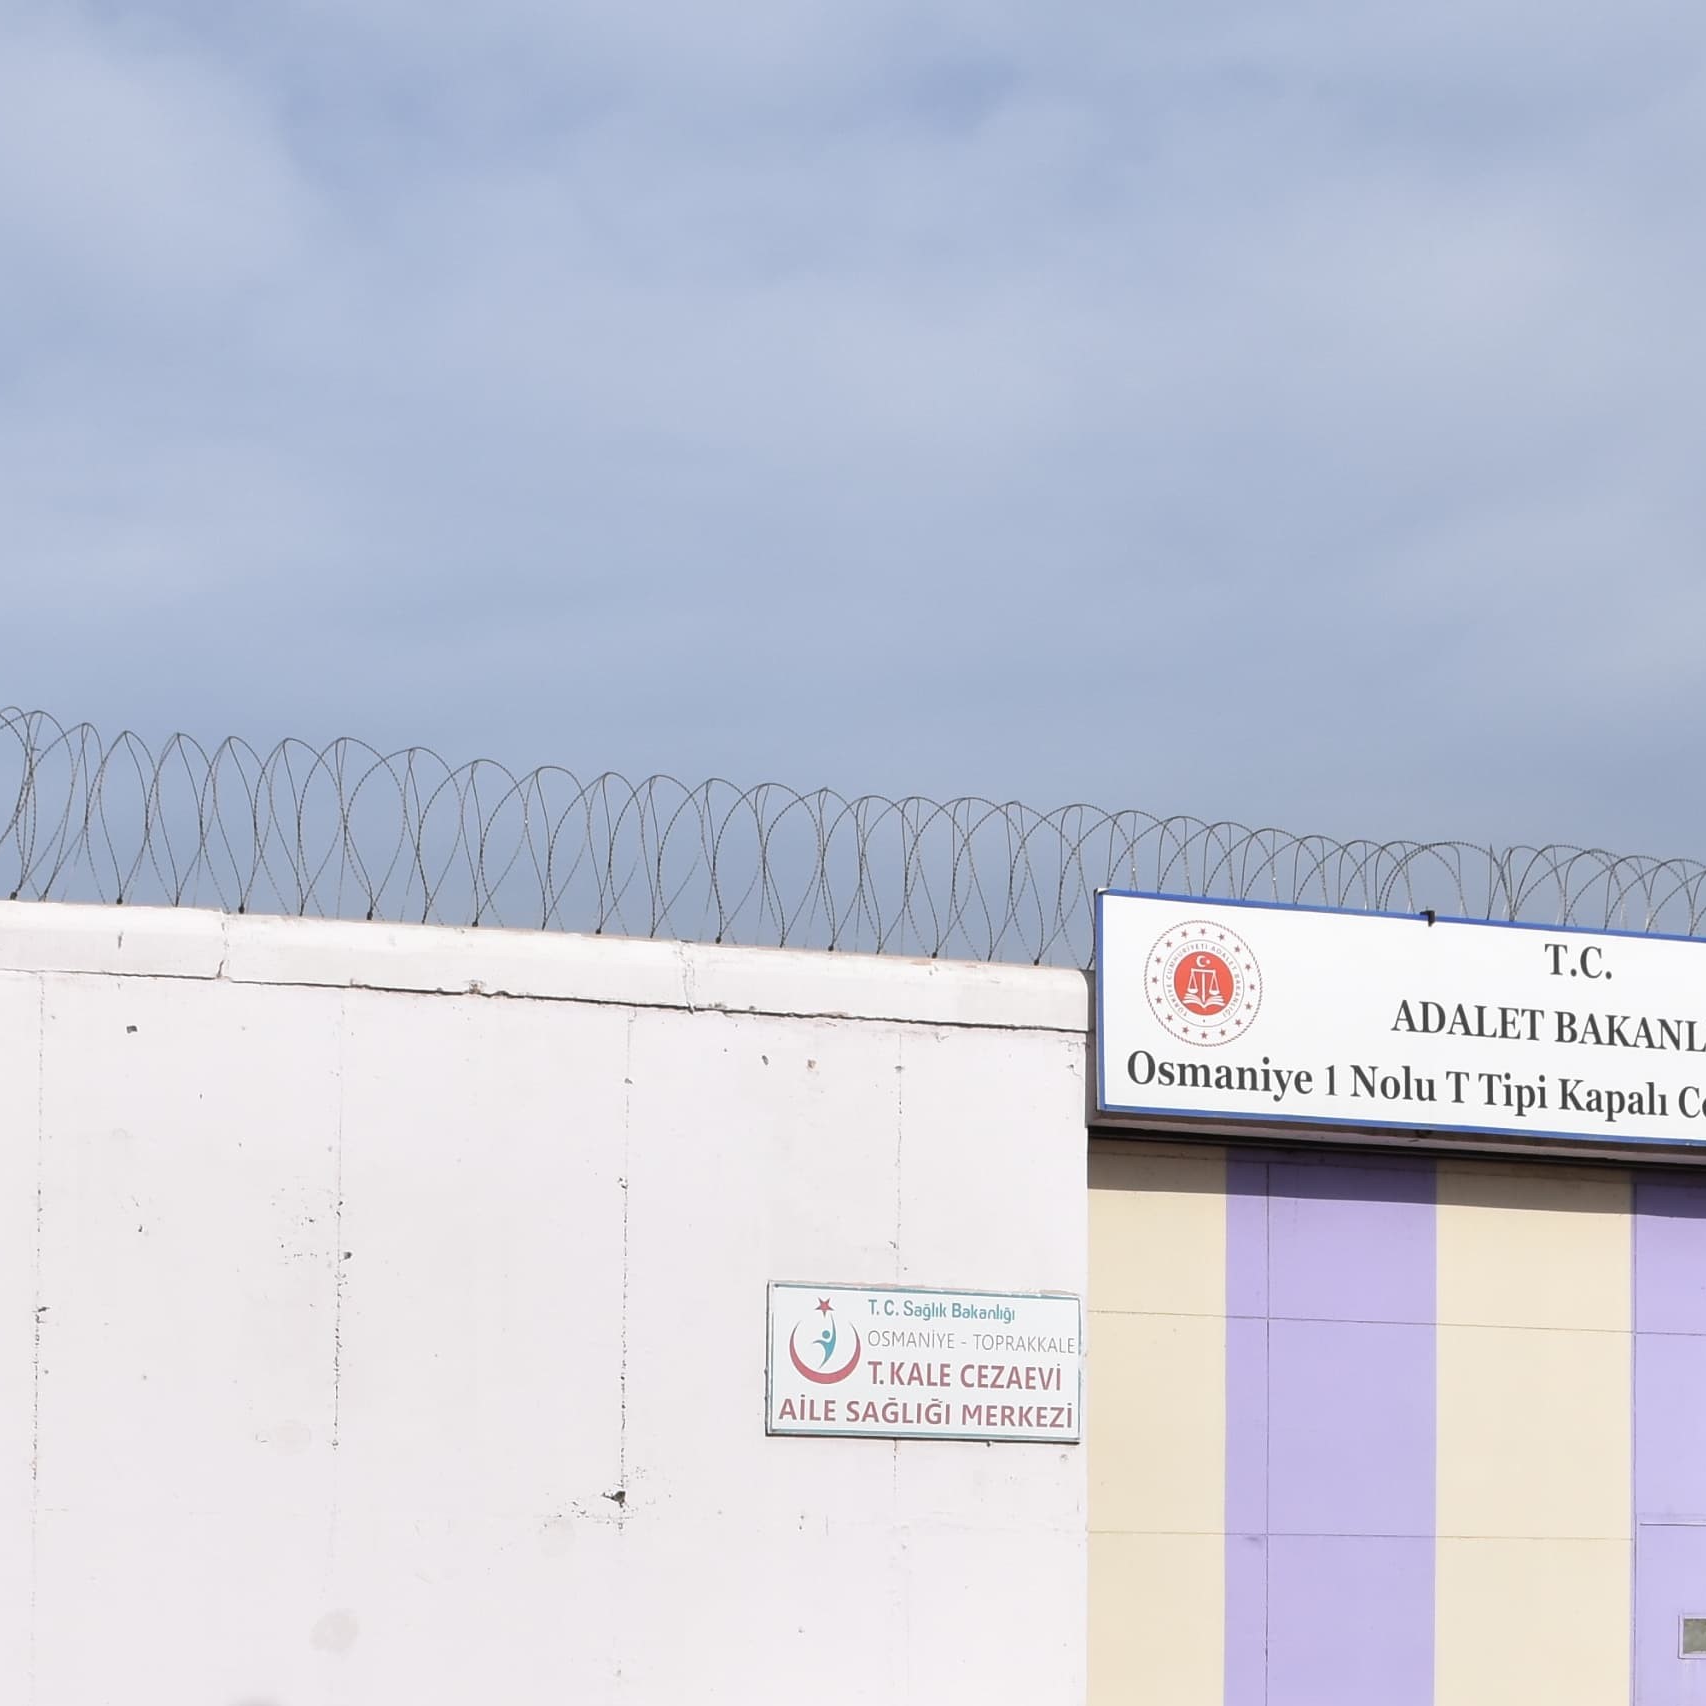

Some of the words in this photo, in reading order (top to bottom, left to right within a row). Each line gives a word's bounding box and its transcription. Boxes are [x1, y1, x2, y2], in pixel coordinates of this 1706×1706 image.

[1545, 943, 1613, 980] T.C.
[1391, 999, 1544, 1041] ADALET
[1127, 1050, 1313, 1102] Osmaniye
[1325, 1064, 1339, 1096] 1
[1350, 1064, 1437, 1101] Nolu
[1446, 1070, 1470, 1104] T
[1478, 1072, 1548, 1117] Tipi
[1558, 1078, 1669, 1123] Kapalı
[868, 1299, 880, 1316] T.
[884, 1300, 899, 1316] C.
[903, 1300, 947, 1321] Sağlık
[952, 1302, 1016, 1324] Bakanlığı
[868, 1329, 955, 1349] OSMANİYE
[973, 1334, 1076, 1354] TOPRAKKALE
[960, 1363, 1062, 1391] CEZAEVİ
[778, 1394, 836, 1422] AİLE
[845, 1397, 951, 1425] SAĞLIĞI
[961, 1402, 1073, 1428] MERKEZİ
